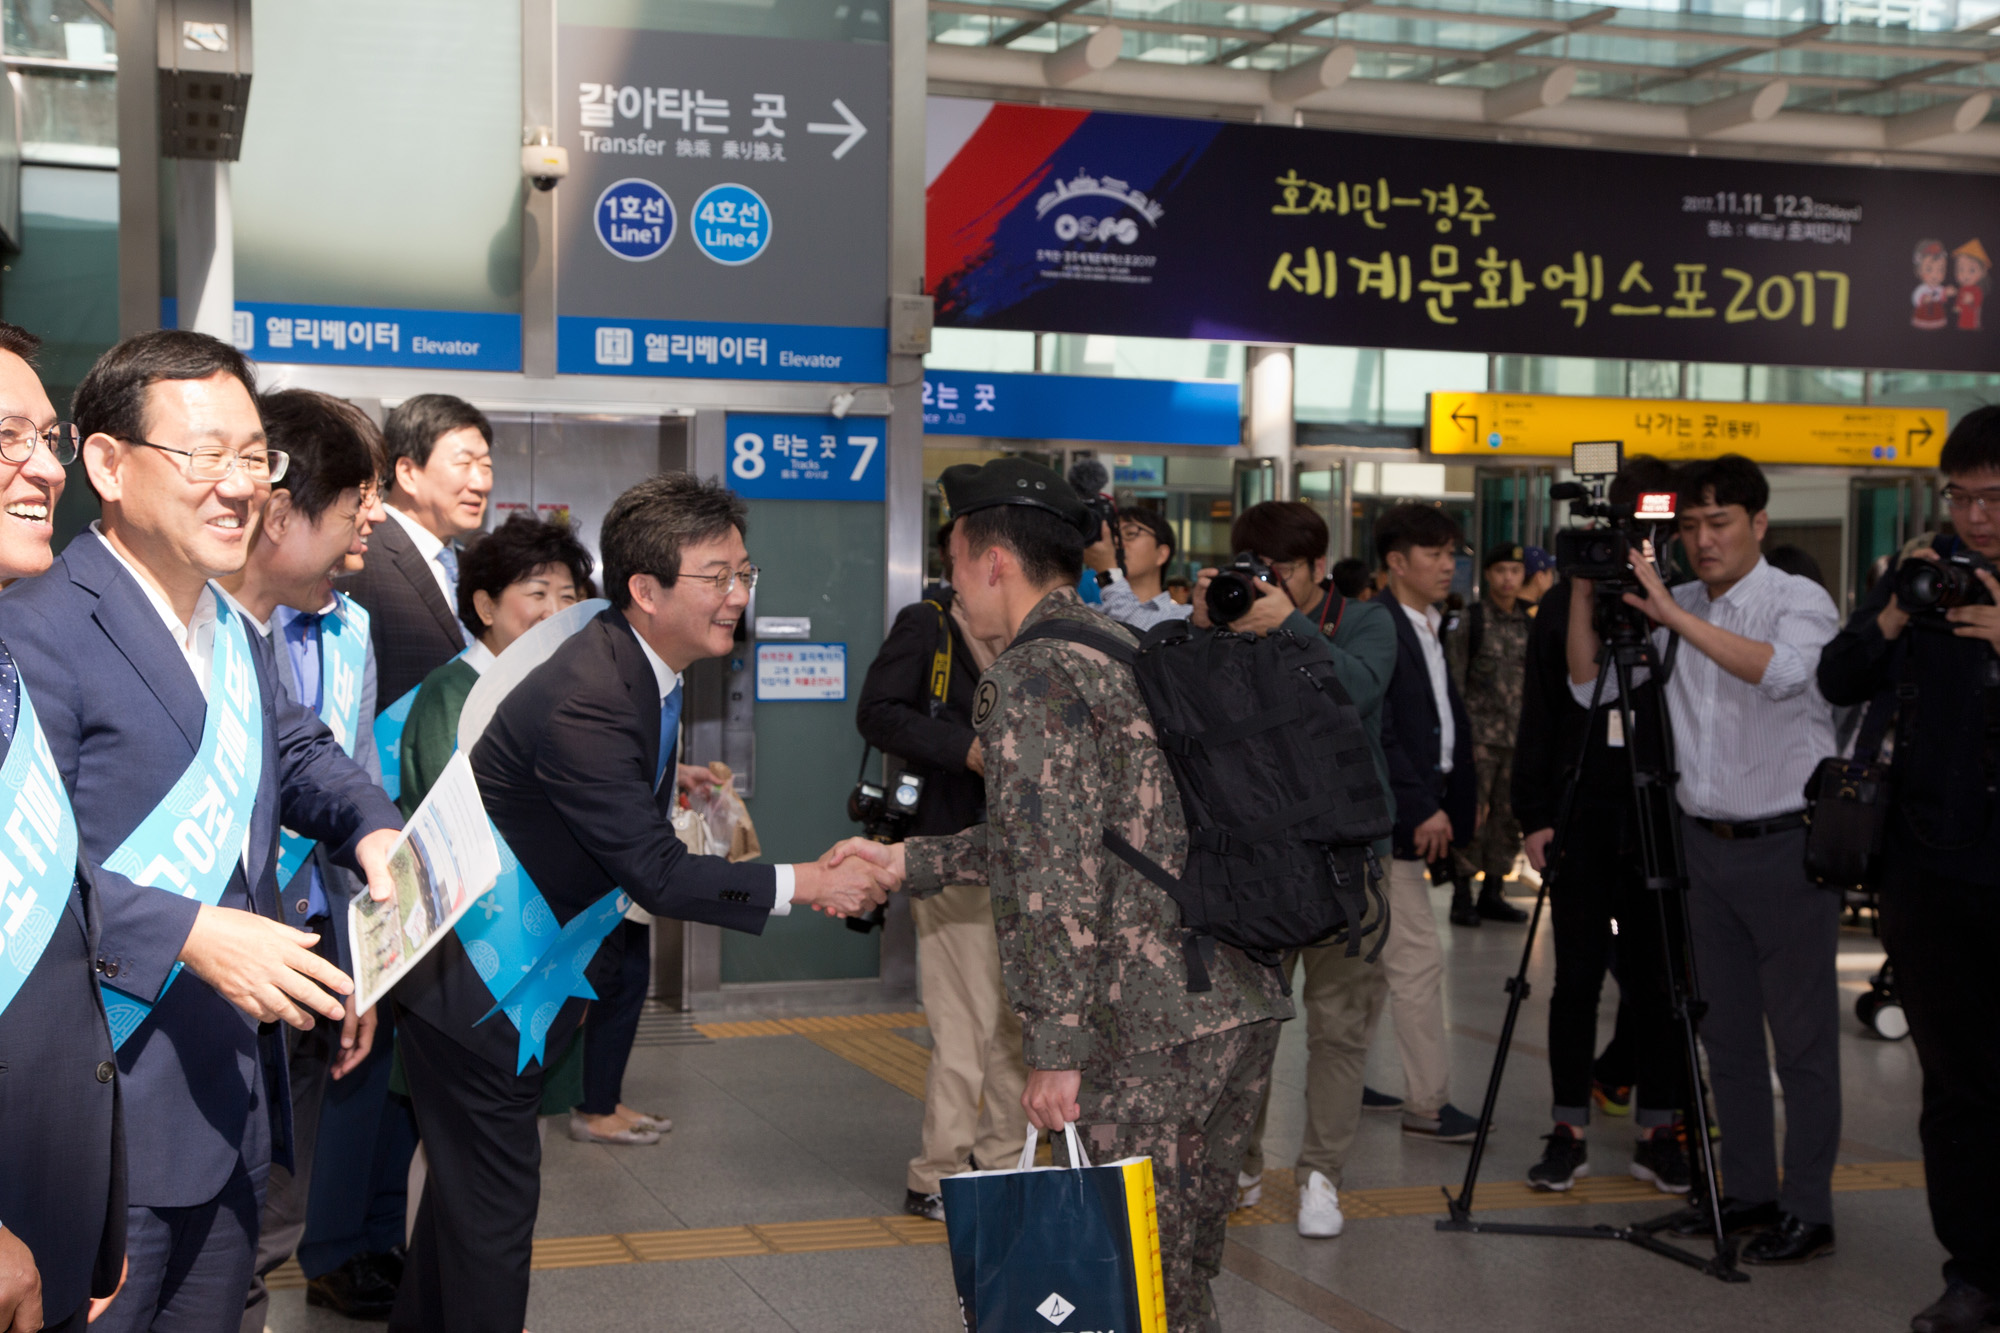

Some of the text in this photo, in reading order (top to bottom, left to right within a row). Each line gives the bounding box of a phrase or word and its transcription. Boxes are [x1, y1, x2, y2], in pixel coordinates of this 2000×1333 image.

[579, 83, 787, 138] 갈아타는 곳
[579, 131, 666, 155] Transfer
[605, 196, 664, 224] 1호선
[699, 201, 760, 228] 4호선
[265, 316, 399, 353] 엘리베이터
[411, 336, 480, 357] Elevator
[644, 331, 768, 365] 엘리베이터
[779, 350, 842, 369] Elevator
[974, 383, 996, 412] 곳
[1635, 412, 1692, 437] 나가는
[732, 432, 766, 480] 8
[772, 433, 837, 459] 타는 곳
[847, 435, 879, 482] 7
[790, 458, 820, 470] Tracks
[1643, 494, 1671, 504] MBC
[134, 632, 252, 899] 바른정
